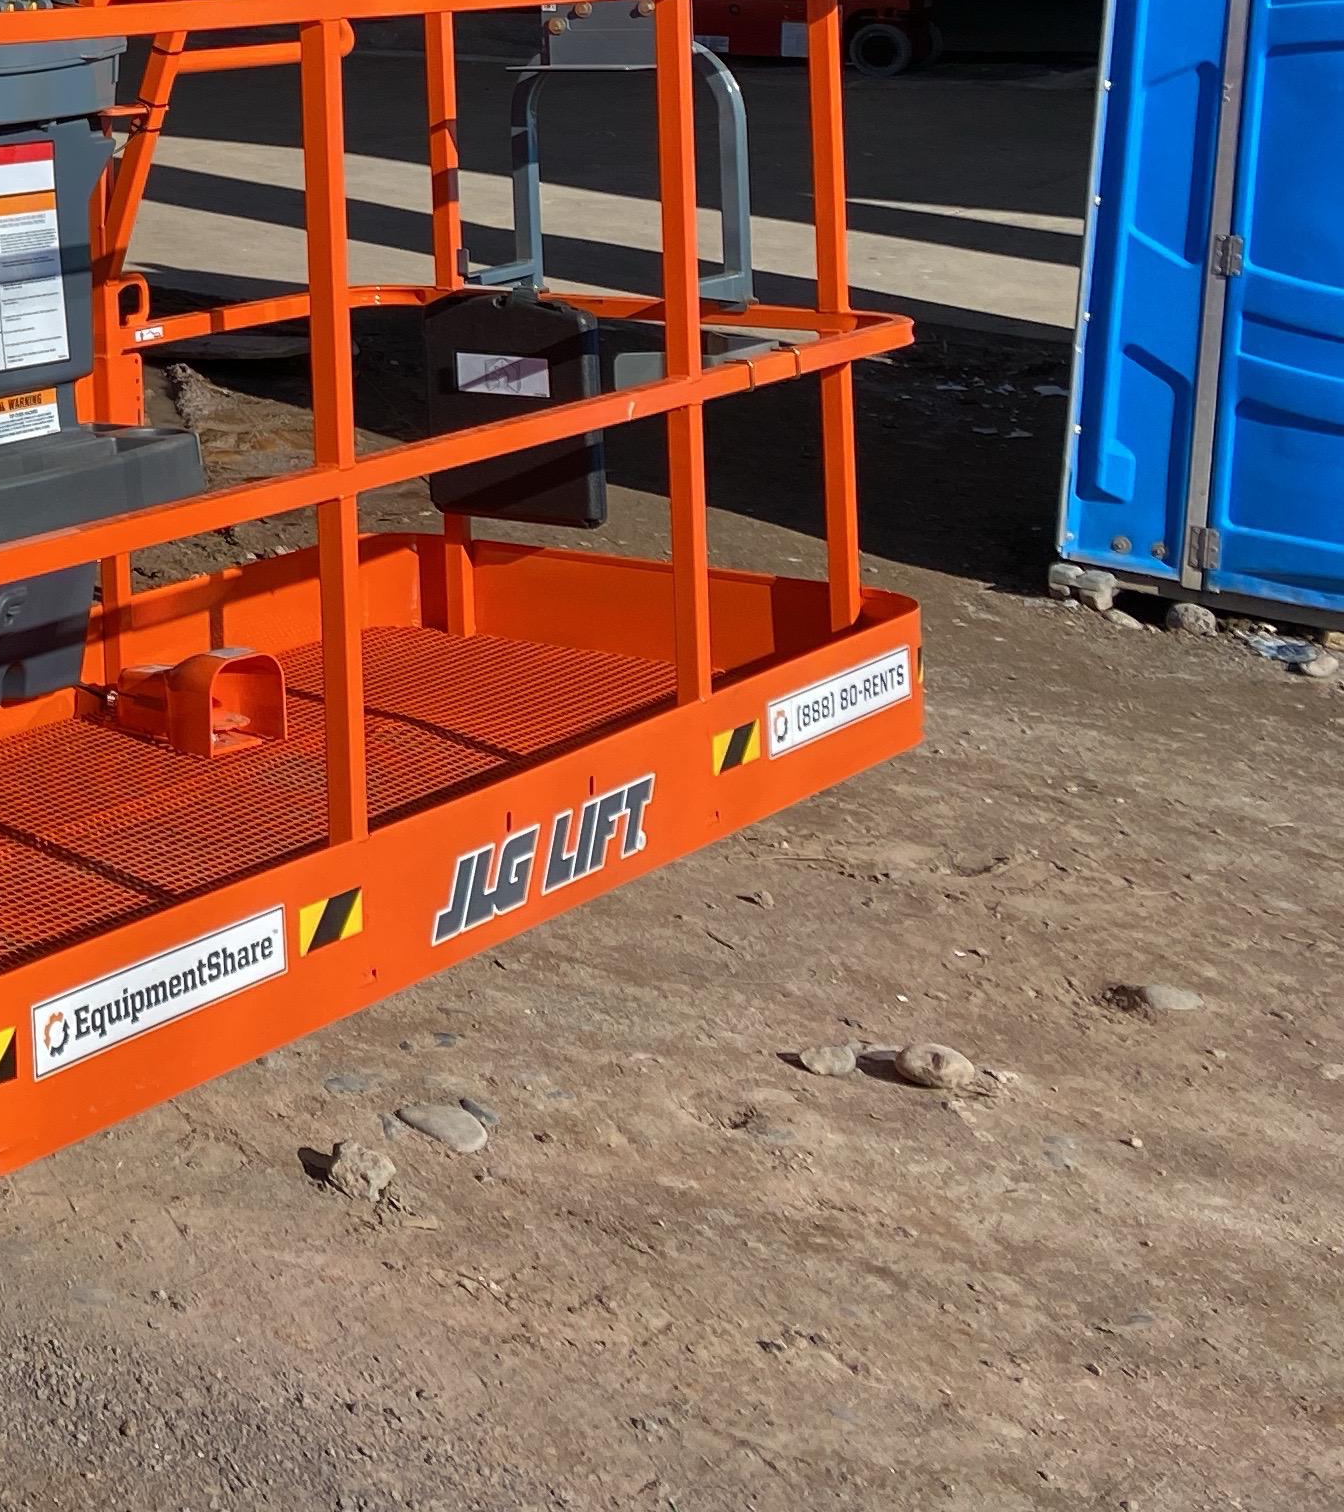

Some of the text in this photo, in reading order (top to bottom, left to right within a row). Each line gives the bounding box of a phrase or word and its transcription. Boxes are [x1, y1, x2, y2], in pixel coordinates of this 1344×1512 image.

[8, 393, 42, 411] WARNING
[796, 663, 906, 732] (888) 80-RENTS
[431, 772, 656, 948] JLG LIFT
[73, 935, 274, 1041] EquipmentShare
